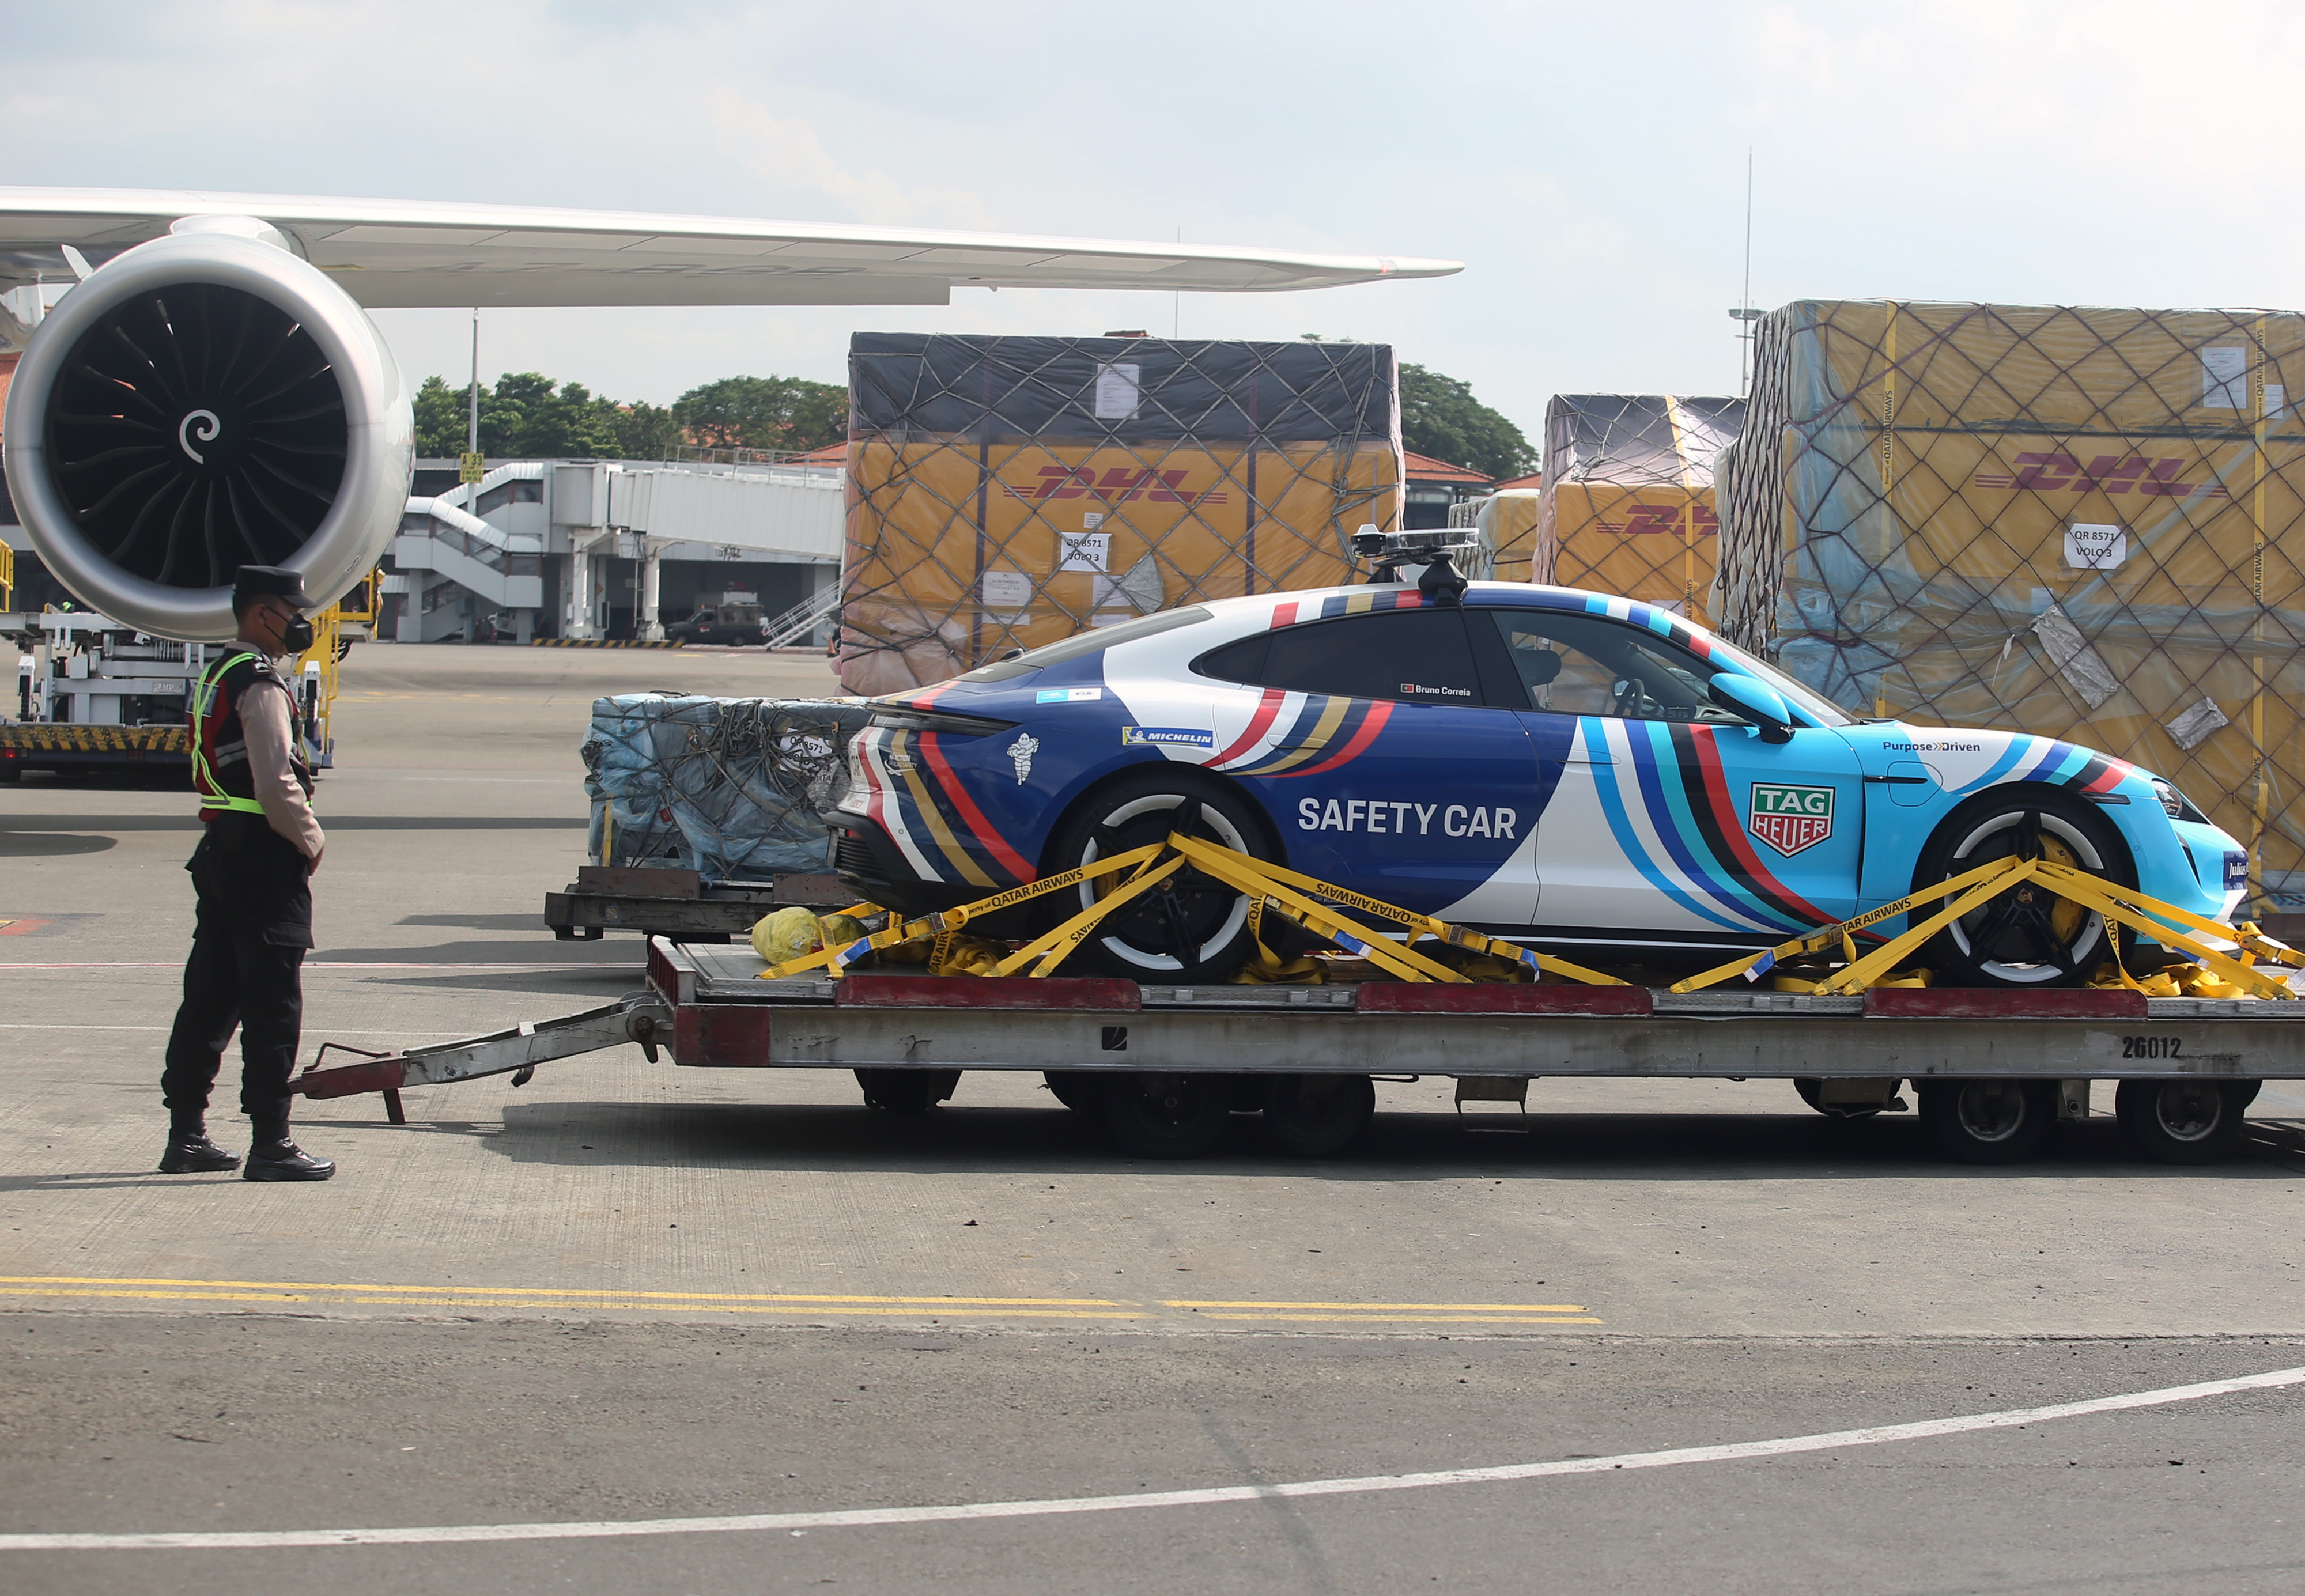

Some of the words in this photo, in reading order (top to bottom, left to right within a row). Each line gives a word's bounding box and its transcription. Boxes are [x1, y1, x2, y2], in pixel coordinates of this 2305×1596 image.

[2256, 367, 2264, 396] QATAR
[1885, 390, 1893, 429] IRWAYS
[1884, 429, 1892, 459] QATAR
[471, 455, 482, 466] 33
[1033, 466, 1197, 502] DHL
[2009, 452, 2195, 497] DHL
[1623, 505, 1720, 536] DH
[1082, 539, 1102, 547] 8571
[2074, 531, 2089, 540] QR
[2092, 532, 2114, 541] 8571
[2076, 547, 2103, 557] VOLO
[2106, 549, 2112, 557] 3
[1415, 684, 1440, 694] Bruno
[1441, 686, 1471, 697] Correia
[1147, 732, 1212, 743] MICHELIN
[1883, 742, 1933, 753] Purpose
[1942, 742, 1981, 751] Driven
[1760, 790, 1825, 813] TAG
[1298, 797, 1438, 835] SAFETY
[1444, 804, 1517, 839] CAR
[1756, 817, 1826, 850] HEUER
[2228, 862, 2246, 879] Julius
[992, 887, 1031, 907] QATAR
[1031, 869, 1083, 895] AIRWAYS
[1316, 883, 1370, 909] AIRWAYS
[1249, 895, 1262, 920] QAT
[1370, 902, 1411, 922] QATAR
[1842, 918, 1862, 932] TAR
[1863, 898, 1911, 925] AIRWAYS
[2104, 915, 2118, 941] QAT
[2122, 1036, 2181, 1059] 26012
